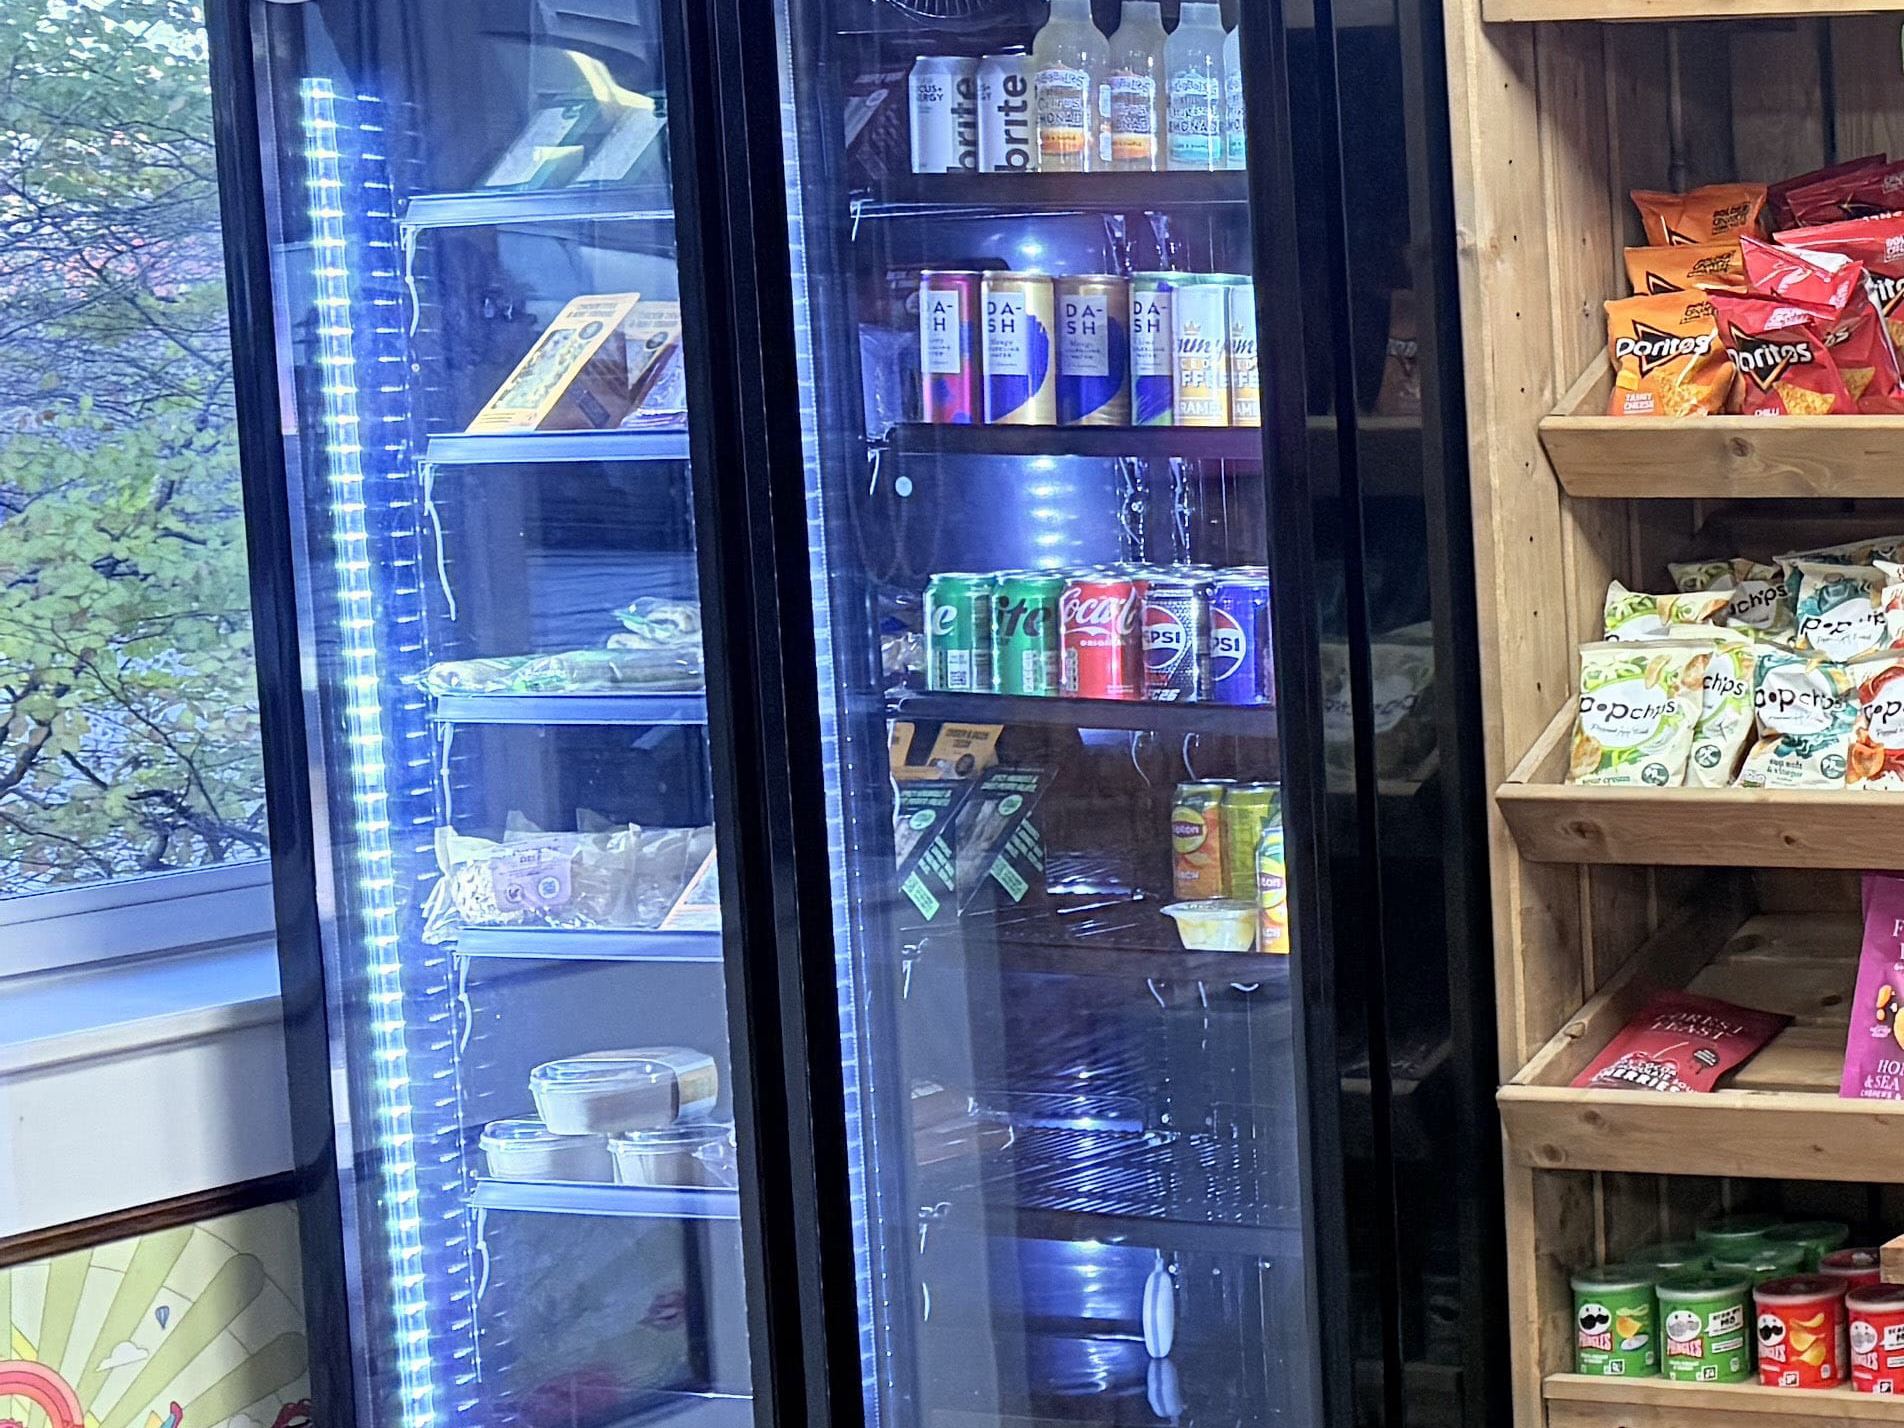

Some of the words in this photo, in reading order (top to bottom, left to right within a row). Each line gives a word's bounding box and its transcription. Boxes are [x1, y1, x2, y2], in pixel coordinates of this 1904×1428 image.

[994, 74, 1030, 172] brite
[1066, 319, 1097, 335] SH
[1133, 318, 1161, 334] SH
[1615, 334, 1711, 361] Doritos
[1726, 341, 1813, 373] Doritos
[1702, 672, 1746, 697] chips
[1864, 1075, 1874, 1088] &
[1875, 1075, 1900, 1092] SEA
